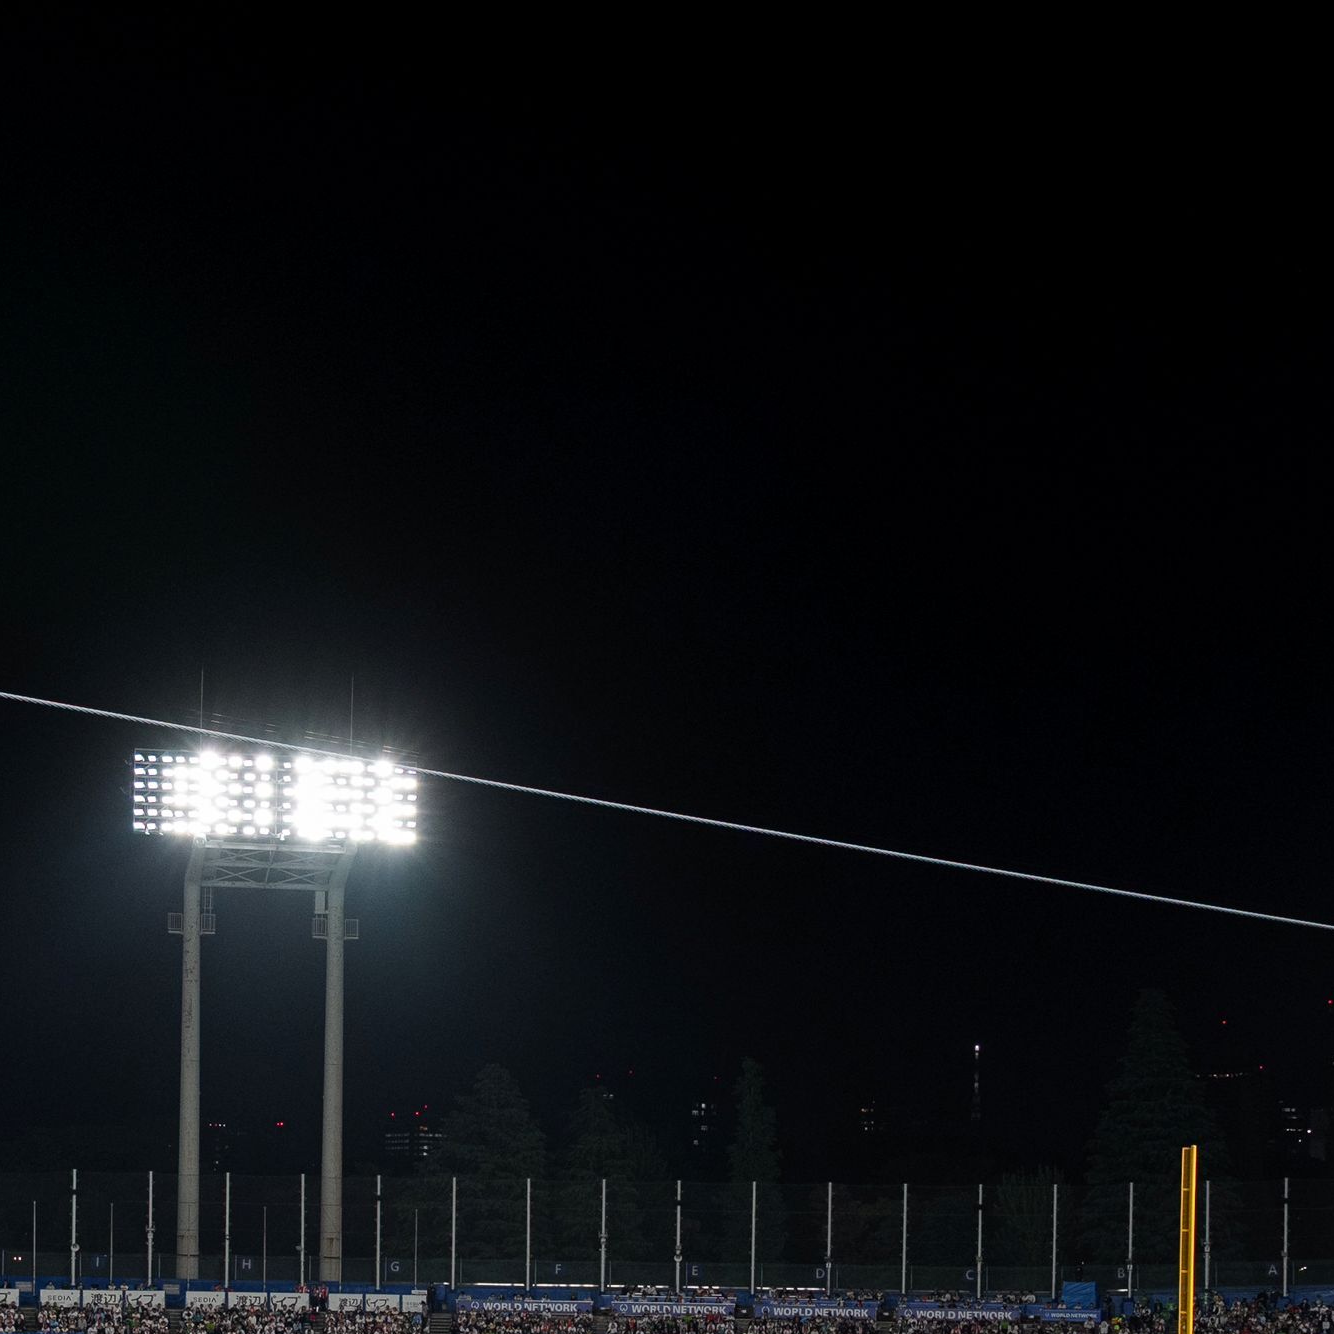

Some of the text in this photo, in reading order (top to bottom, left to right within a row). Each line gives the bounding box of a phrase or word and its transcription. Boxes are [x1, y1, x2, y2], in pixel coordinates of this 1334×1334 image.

[632, 1304, 726, 1315] WORLD NETWORK
[916, 1310, 1012, 1320] WORLD NETWORK
